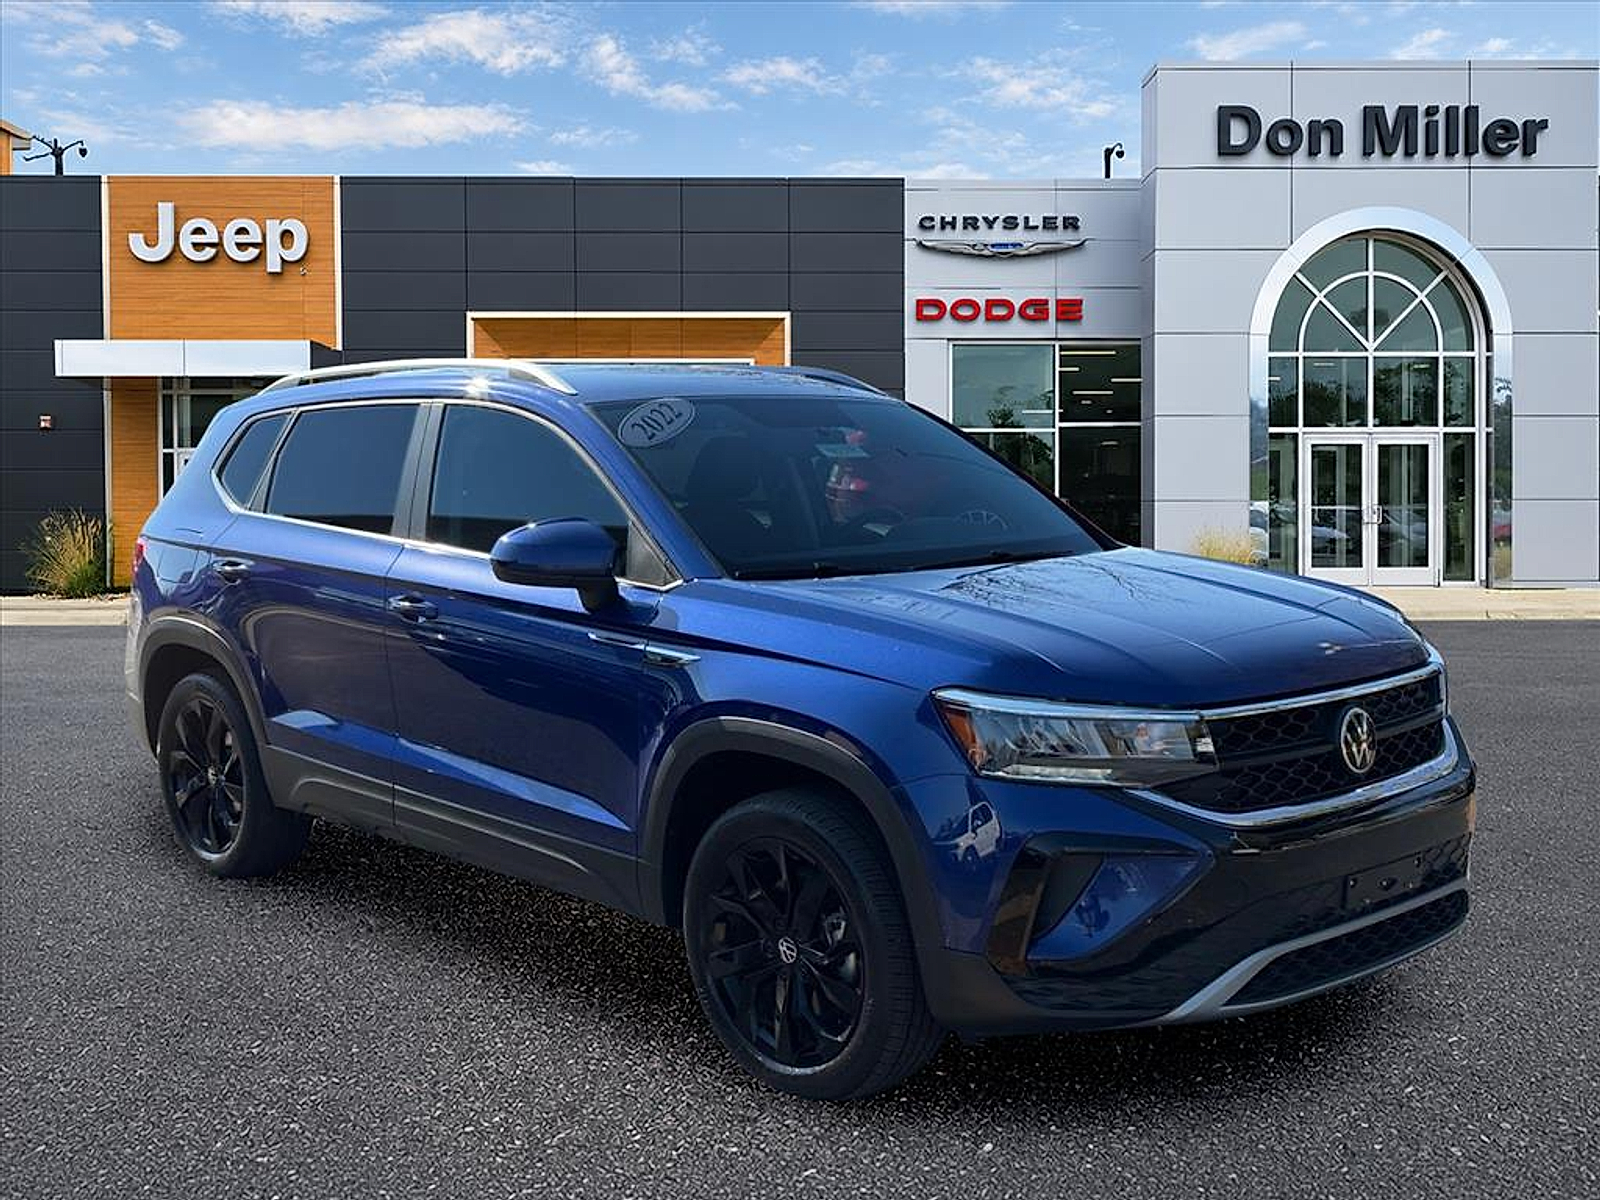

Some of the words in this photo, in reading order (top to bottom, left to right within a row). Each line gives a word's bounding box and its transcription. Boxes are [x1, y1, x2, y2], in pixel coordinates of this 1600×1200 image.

[1217, 104, 1344, 158] Don
[1362, 104, 1549, 158] Miller
[128, 201, 309, 274] Jeep
[918, 214, 1081, 232] CHRYSLER
[915, 298, 1084, 322] DODGE
[630, 403, 683, 441] 2022
